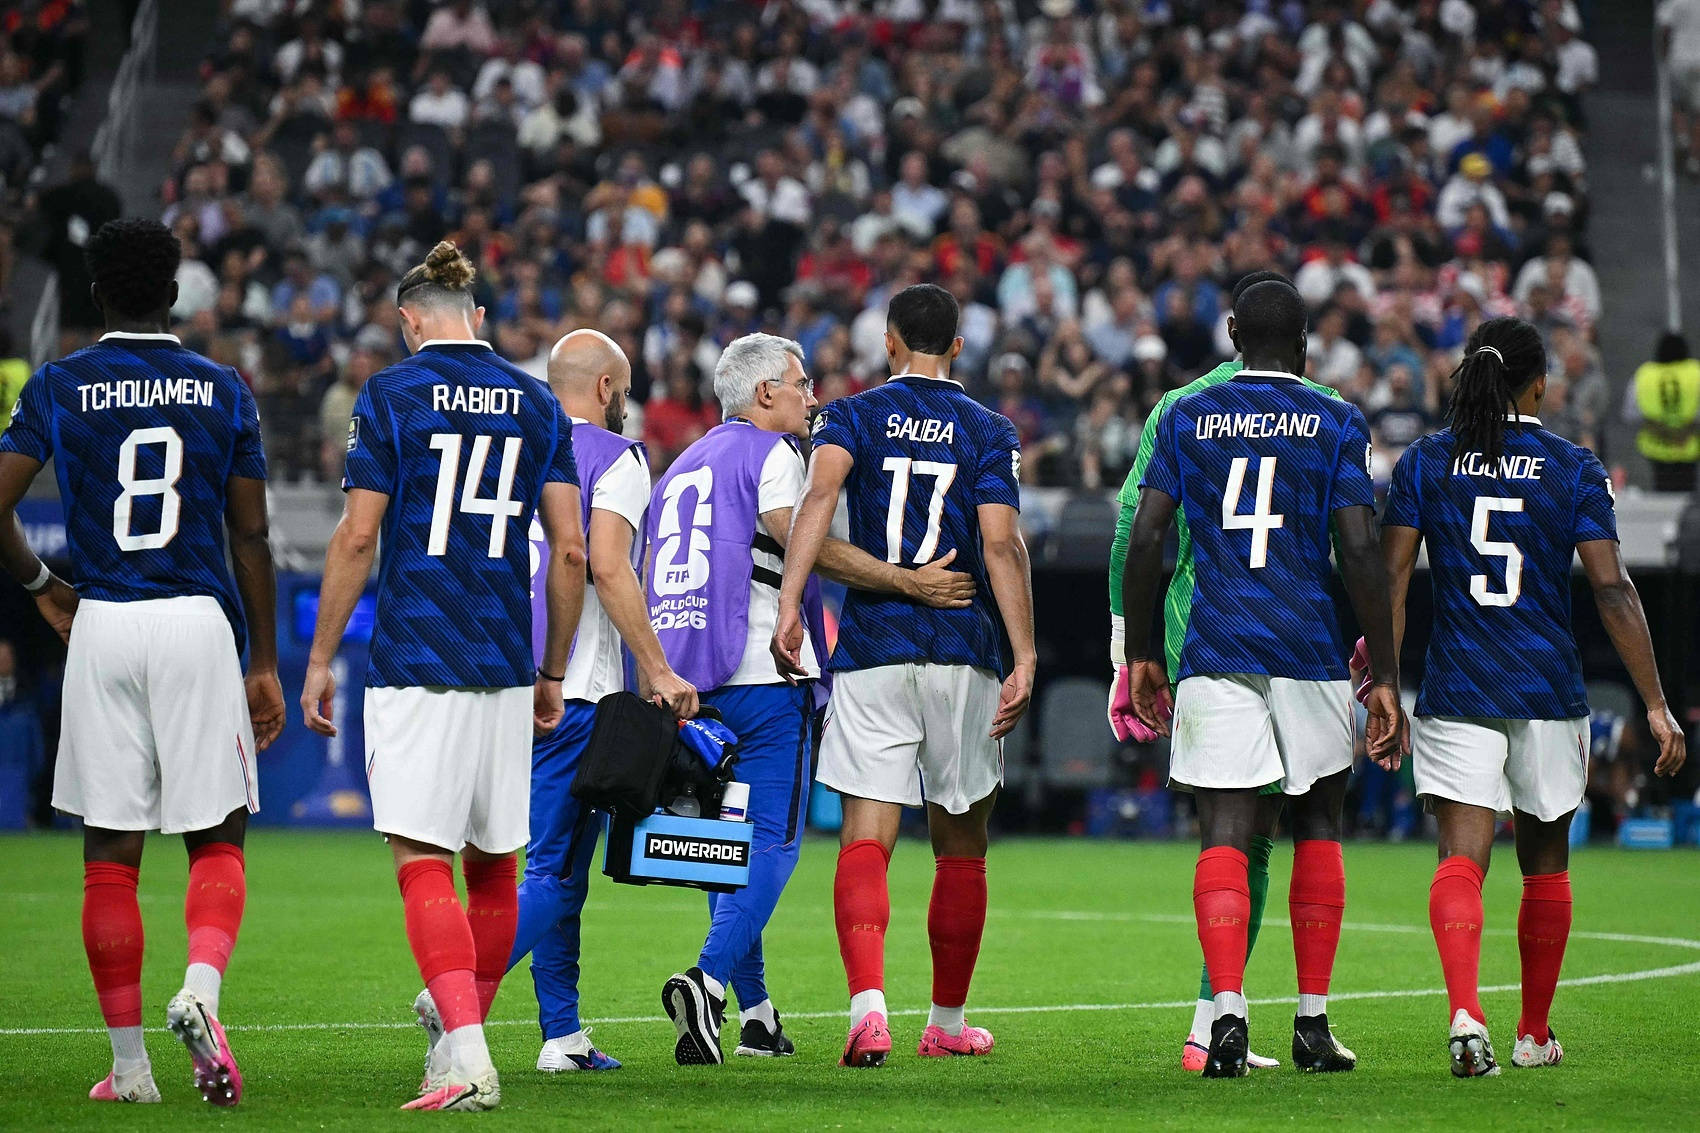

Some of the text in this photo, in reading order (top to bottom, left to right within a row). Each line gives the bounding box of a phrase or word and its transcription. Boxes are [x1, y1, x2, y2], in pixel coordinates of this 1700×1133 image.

[77, 378, 214, 412] TCHOUAMENI
[432, 384, 524, 415] RABIOT
[886, 413, 954, 445] SALIBA
[1195, 412, 1321, 440] UPAMECANO
[114, 426, 184, 552] 8
[427, 433, 524, 559] 14
[882, 456, 958, 564] 17
[1222, 456, 1284, 569] 4
[1469, 496, 1525, 607] 5
[651, 595, 709, 617] WRLD CUP
[650, 609, 707, 635] 2026
[649, 838, 744, 861] POWERADE
[852, 922, 881, 933] FFF
[1207, 916, 1242, 928] FFF
[1296, 921, 1329, 929] FFF
[1444, 922, 1479, 932] FFF
